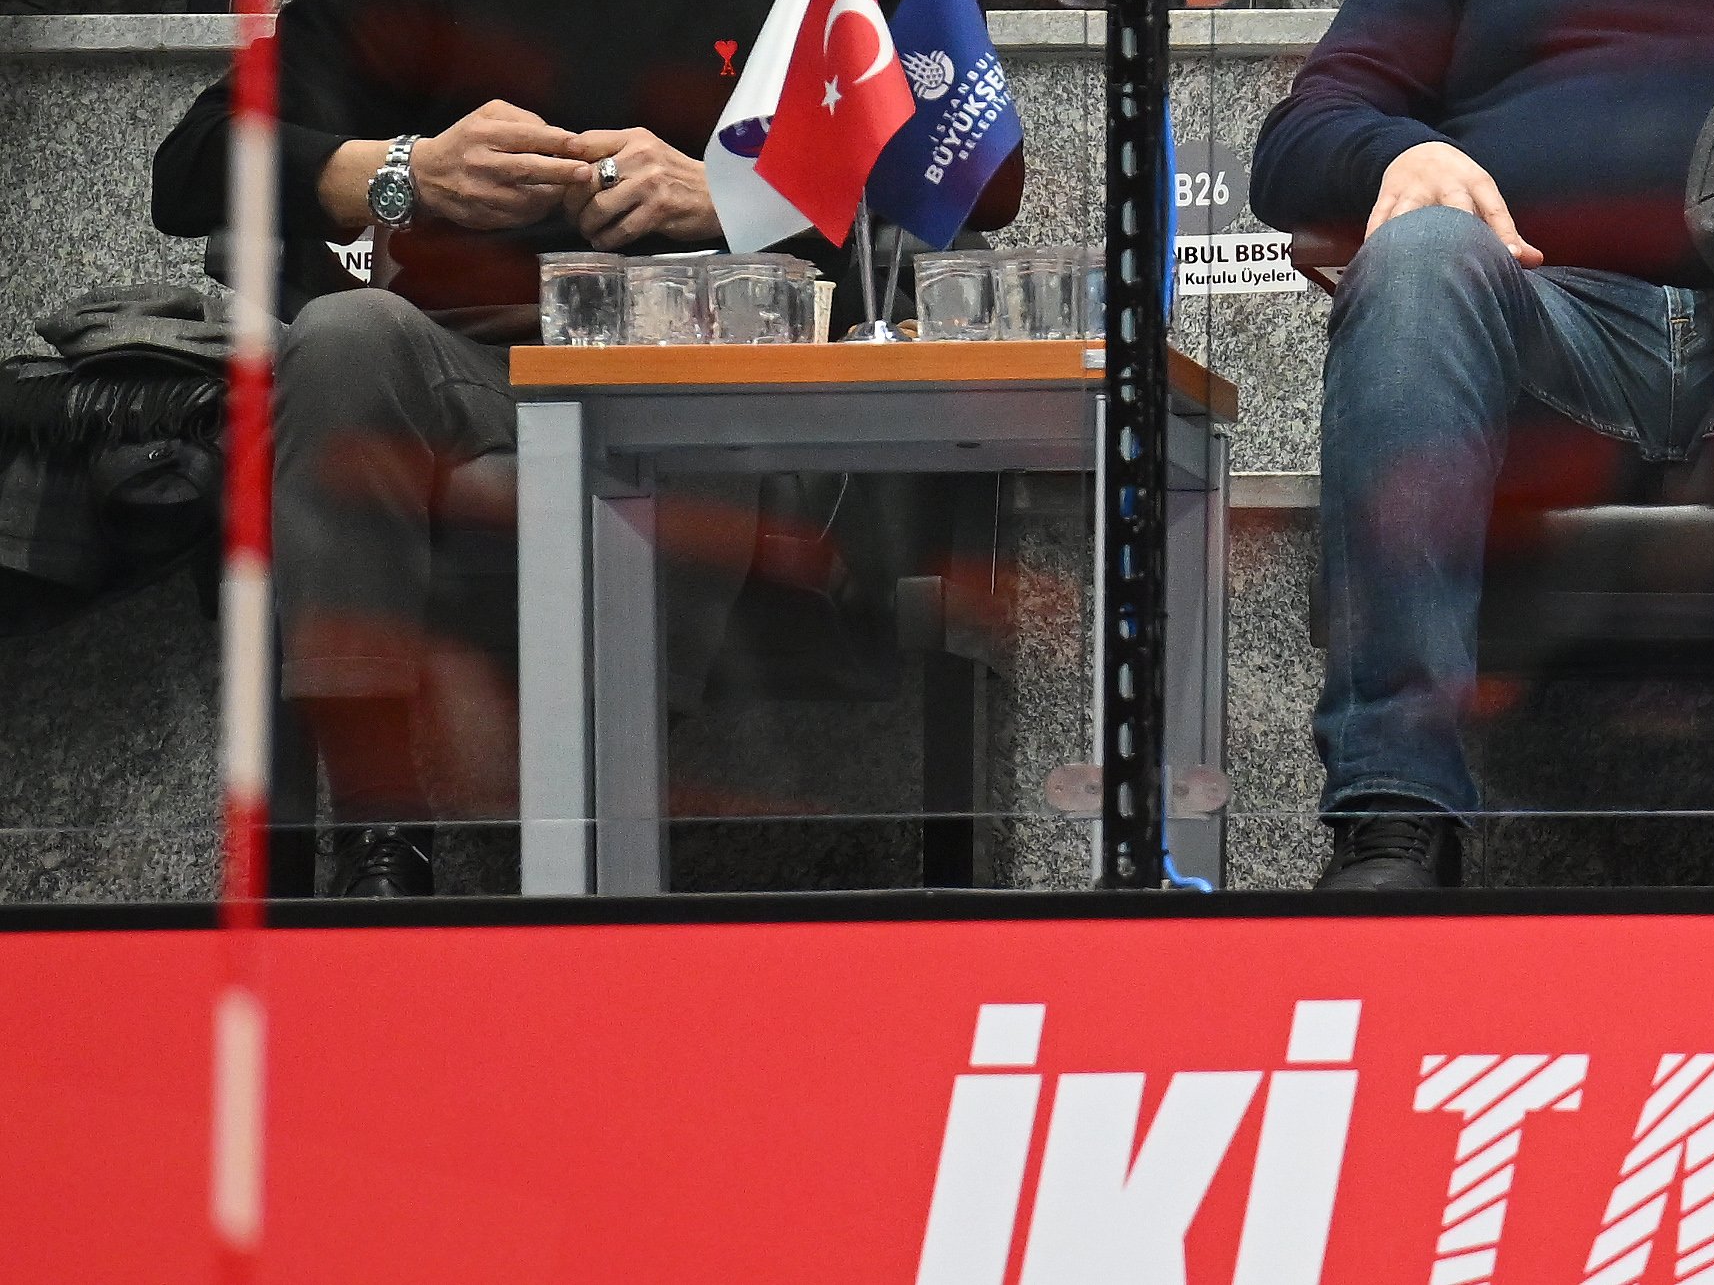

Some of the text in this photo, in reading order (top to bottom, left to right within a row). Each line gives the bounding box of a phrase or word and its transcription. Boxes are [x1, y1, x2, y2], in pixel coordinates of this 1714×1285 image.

[1175, 171, 1230, 207] B26
[1185, 267, 1296, 286] Kurulu Üyeleri
